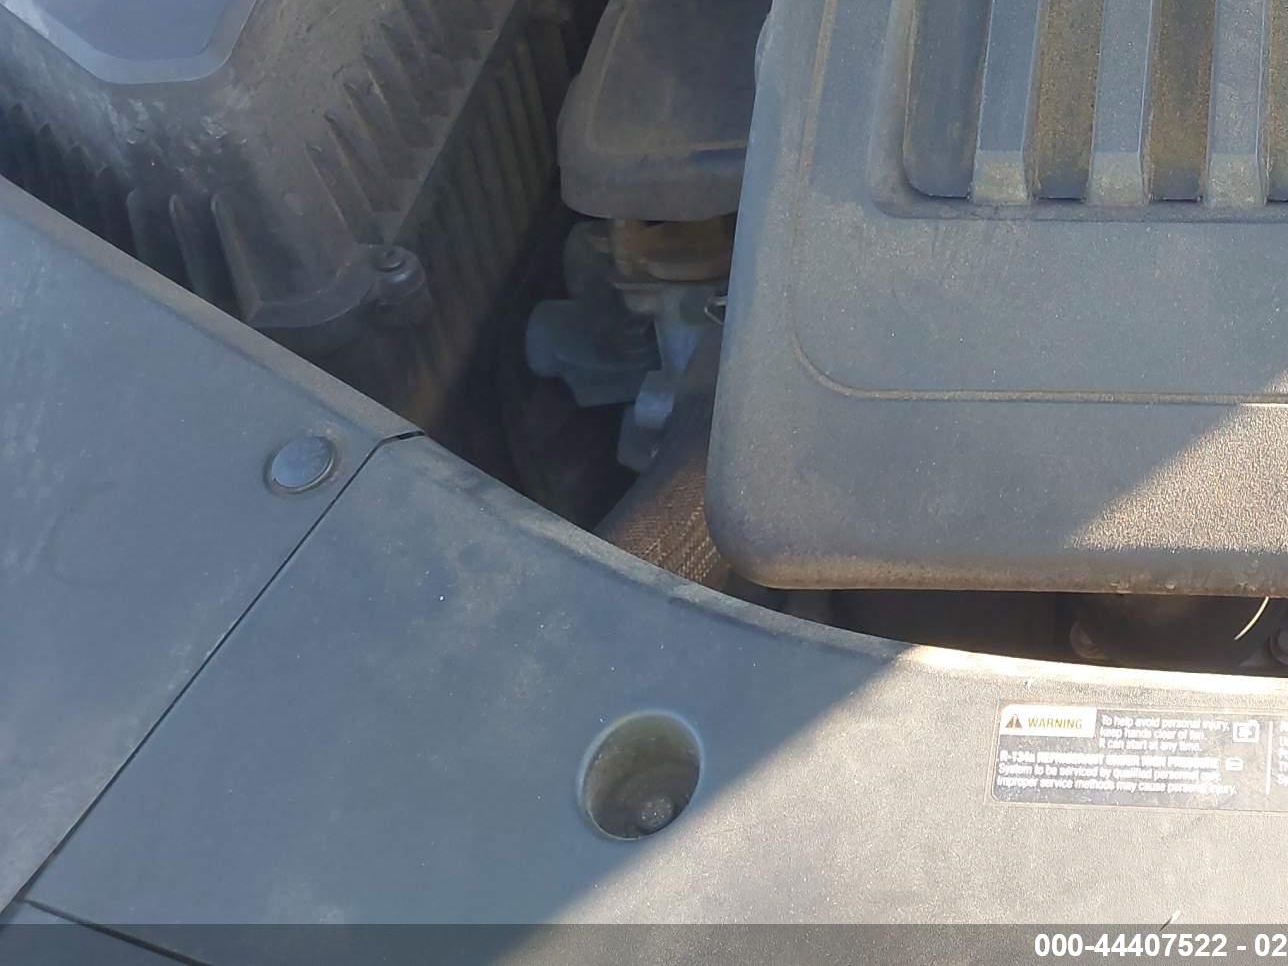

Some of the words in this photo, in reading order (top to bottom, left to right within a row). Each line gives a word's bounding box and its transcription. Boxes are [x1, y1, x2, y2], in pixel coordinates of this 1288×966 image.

[1028, 717, 1083, 730] WARNING
[1113, 716, 1133, 728] help
[1134, 717, 1160, 728] avoid
[1124, 727, 1152, 739] hands
[1153, 728, 1177, 739] clear
[998, 763, 1033, 776] System
[996, 775, 1038, 788] Improper
[1039, 777, 1073, 789] service
[1074, 778, 1115, 790] methods
[1138, 781, 1166, 792] cause
